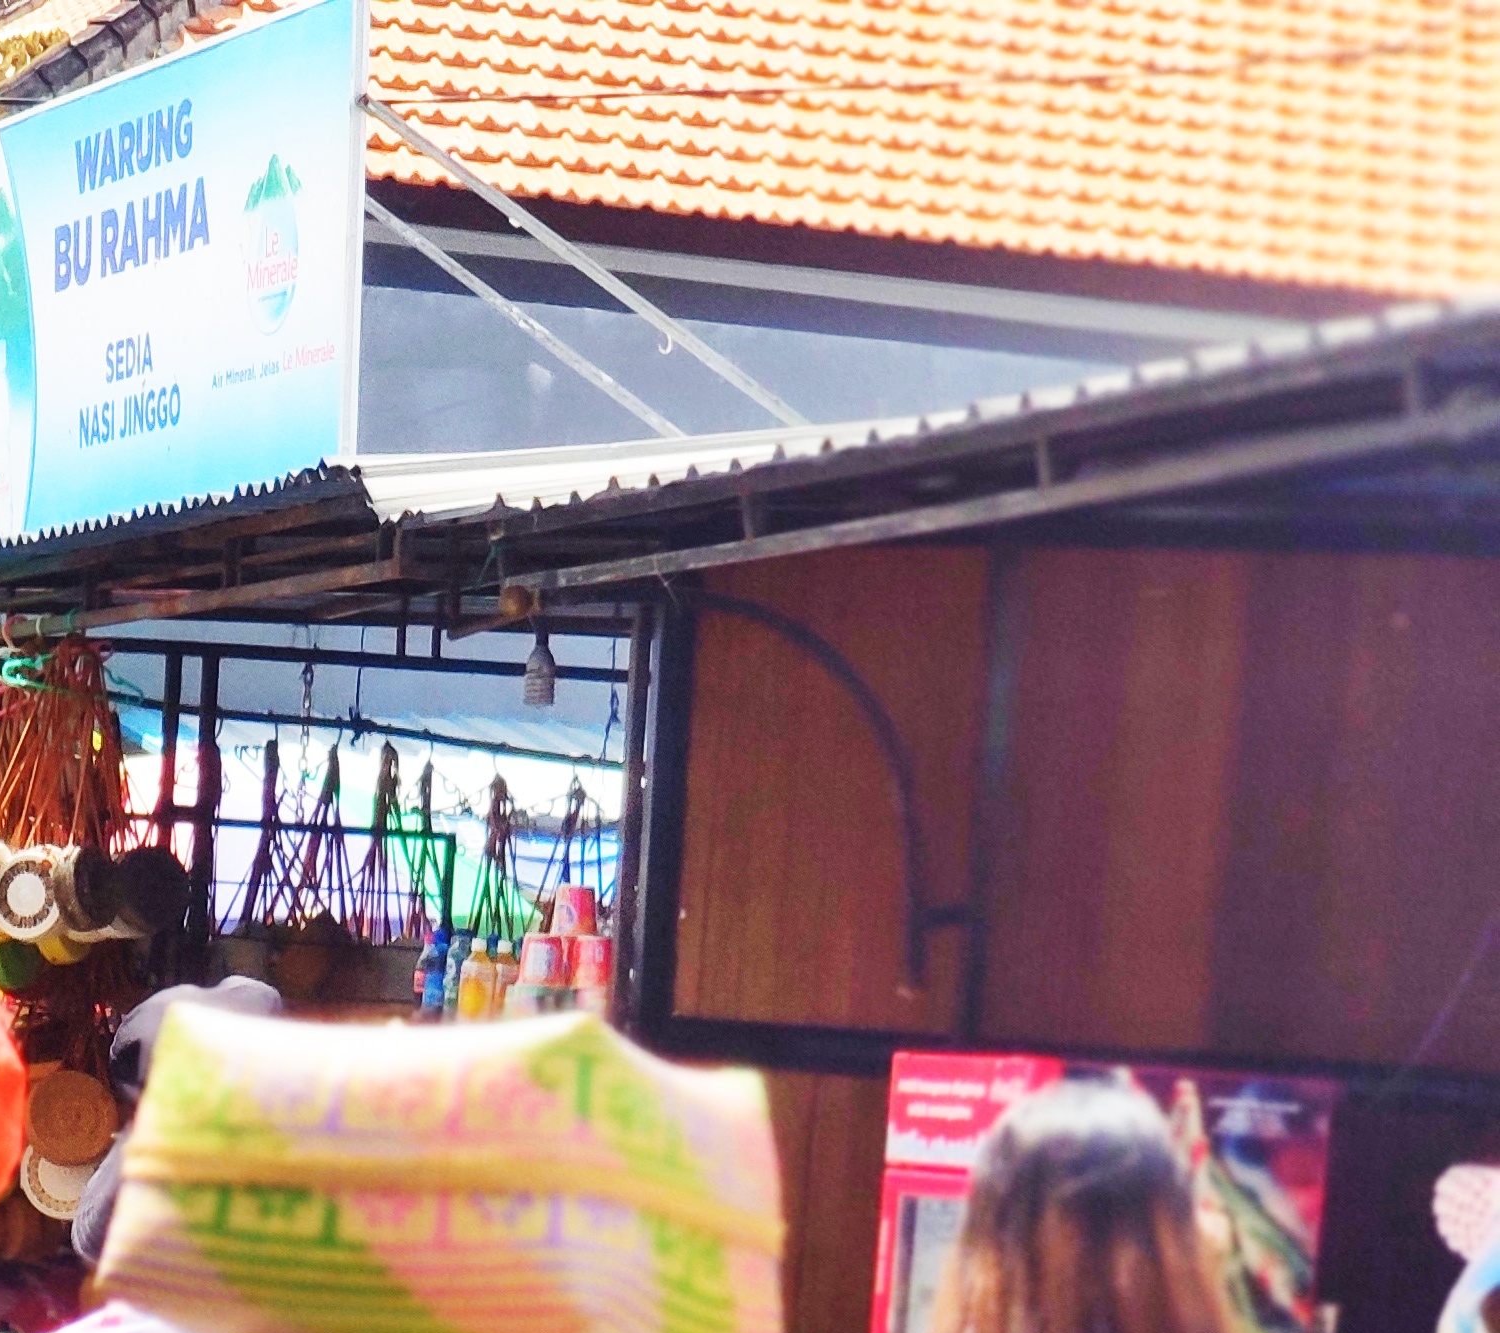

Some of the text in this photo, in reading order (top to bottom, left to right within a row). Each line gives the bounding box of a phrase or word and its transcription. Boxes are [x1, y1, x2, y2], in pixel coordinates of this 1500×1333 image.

[75, 98, 194, 194] WARUNG
[54, 177, 210, 293] BU RAHMA
[265, 226, 279, 258] Le
[247, 252, 298, 289] Minerale
[105, 332, 153, 384] SEDIA
[212, 371, 223, 389] Air
[282, 350, 293, 371] Le
[295, 339, 335, 367] Minerale
[79, 383, 181, 449] NASI JINGGO
